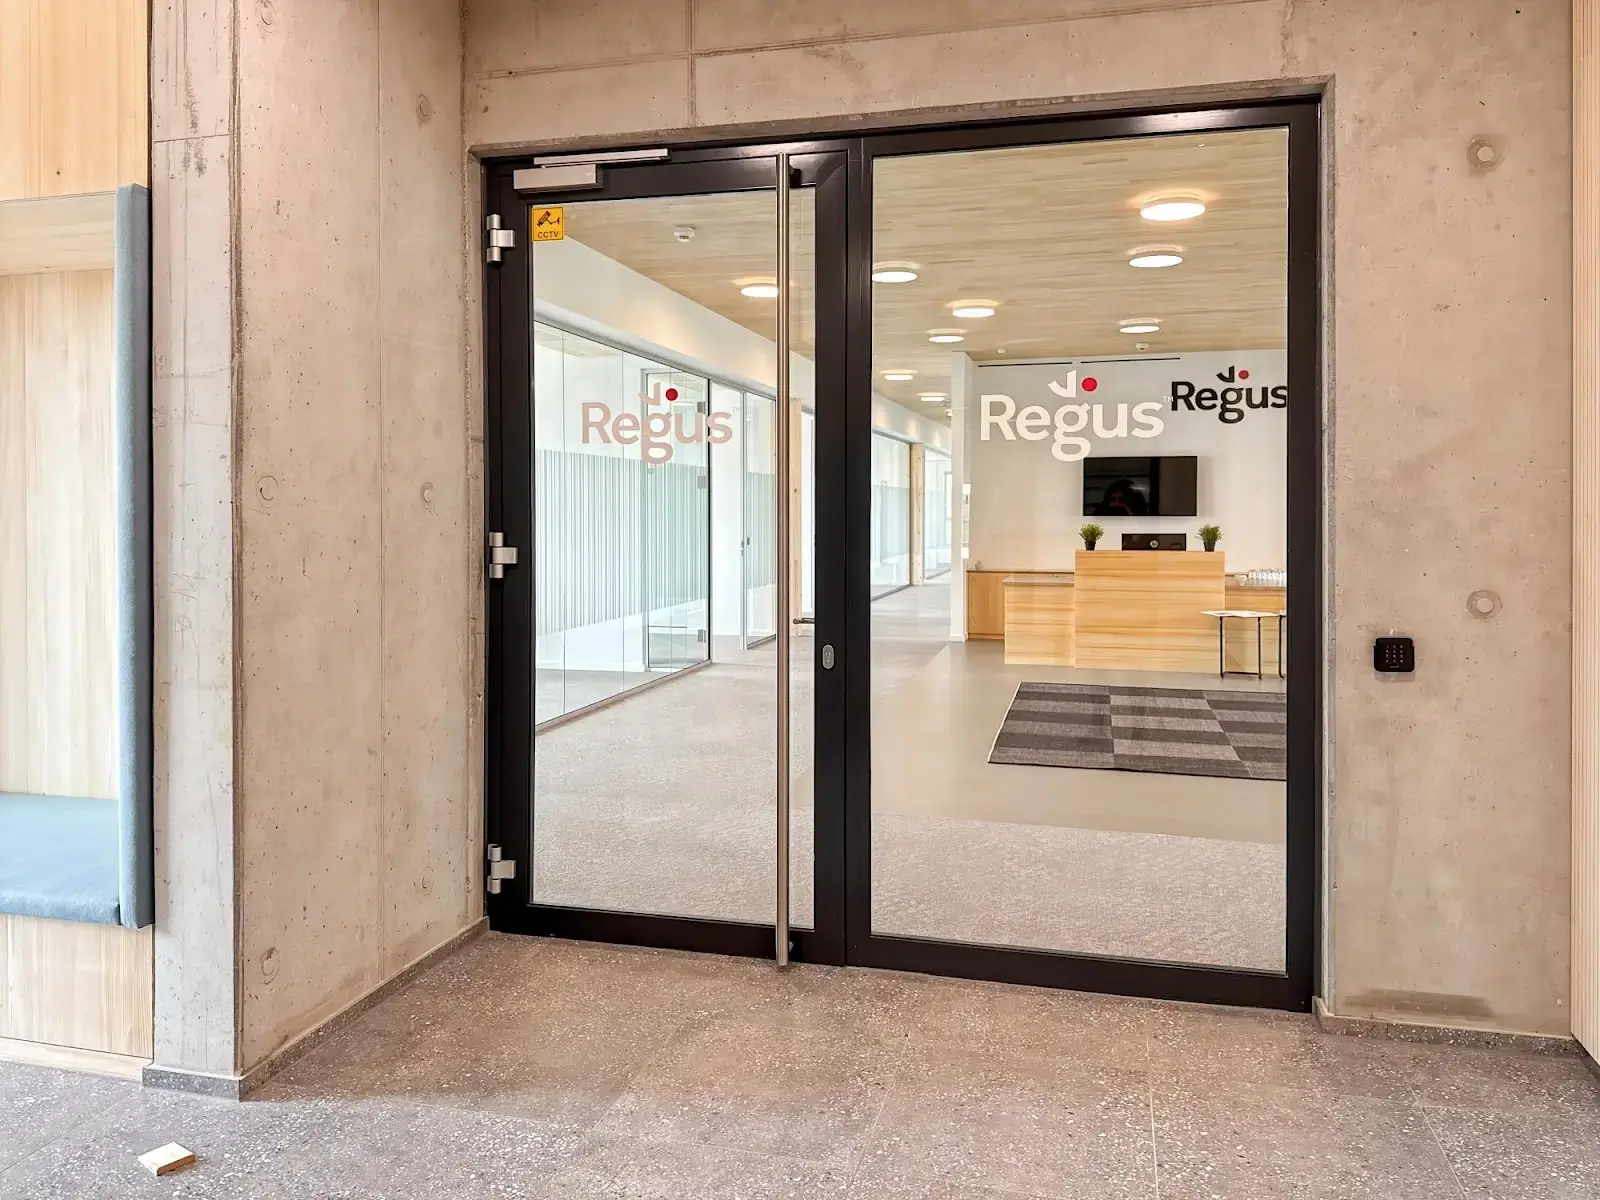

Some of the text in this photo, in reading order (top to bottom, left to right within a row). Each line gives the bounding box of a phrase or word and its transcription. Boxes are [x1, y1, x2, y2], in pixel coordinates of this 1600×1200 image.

[537, 230, 559, 239] CCTV
[980, 394, 1165, 462] Regus
[1171, 381, 1288, 424] Regus
[581, 401, 733, 465] Regus
